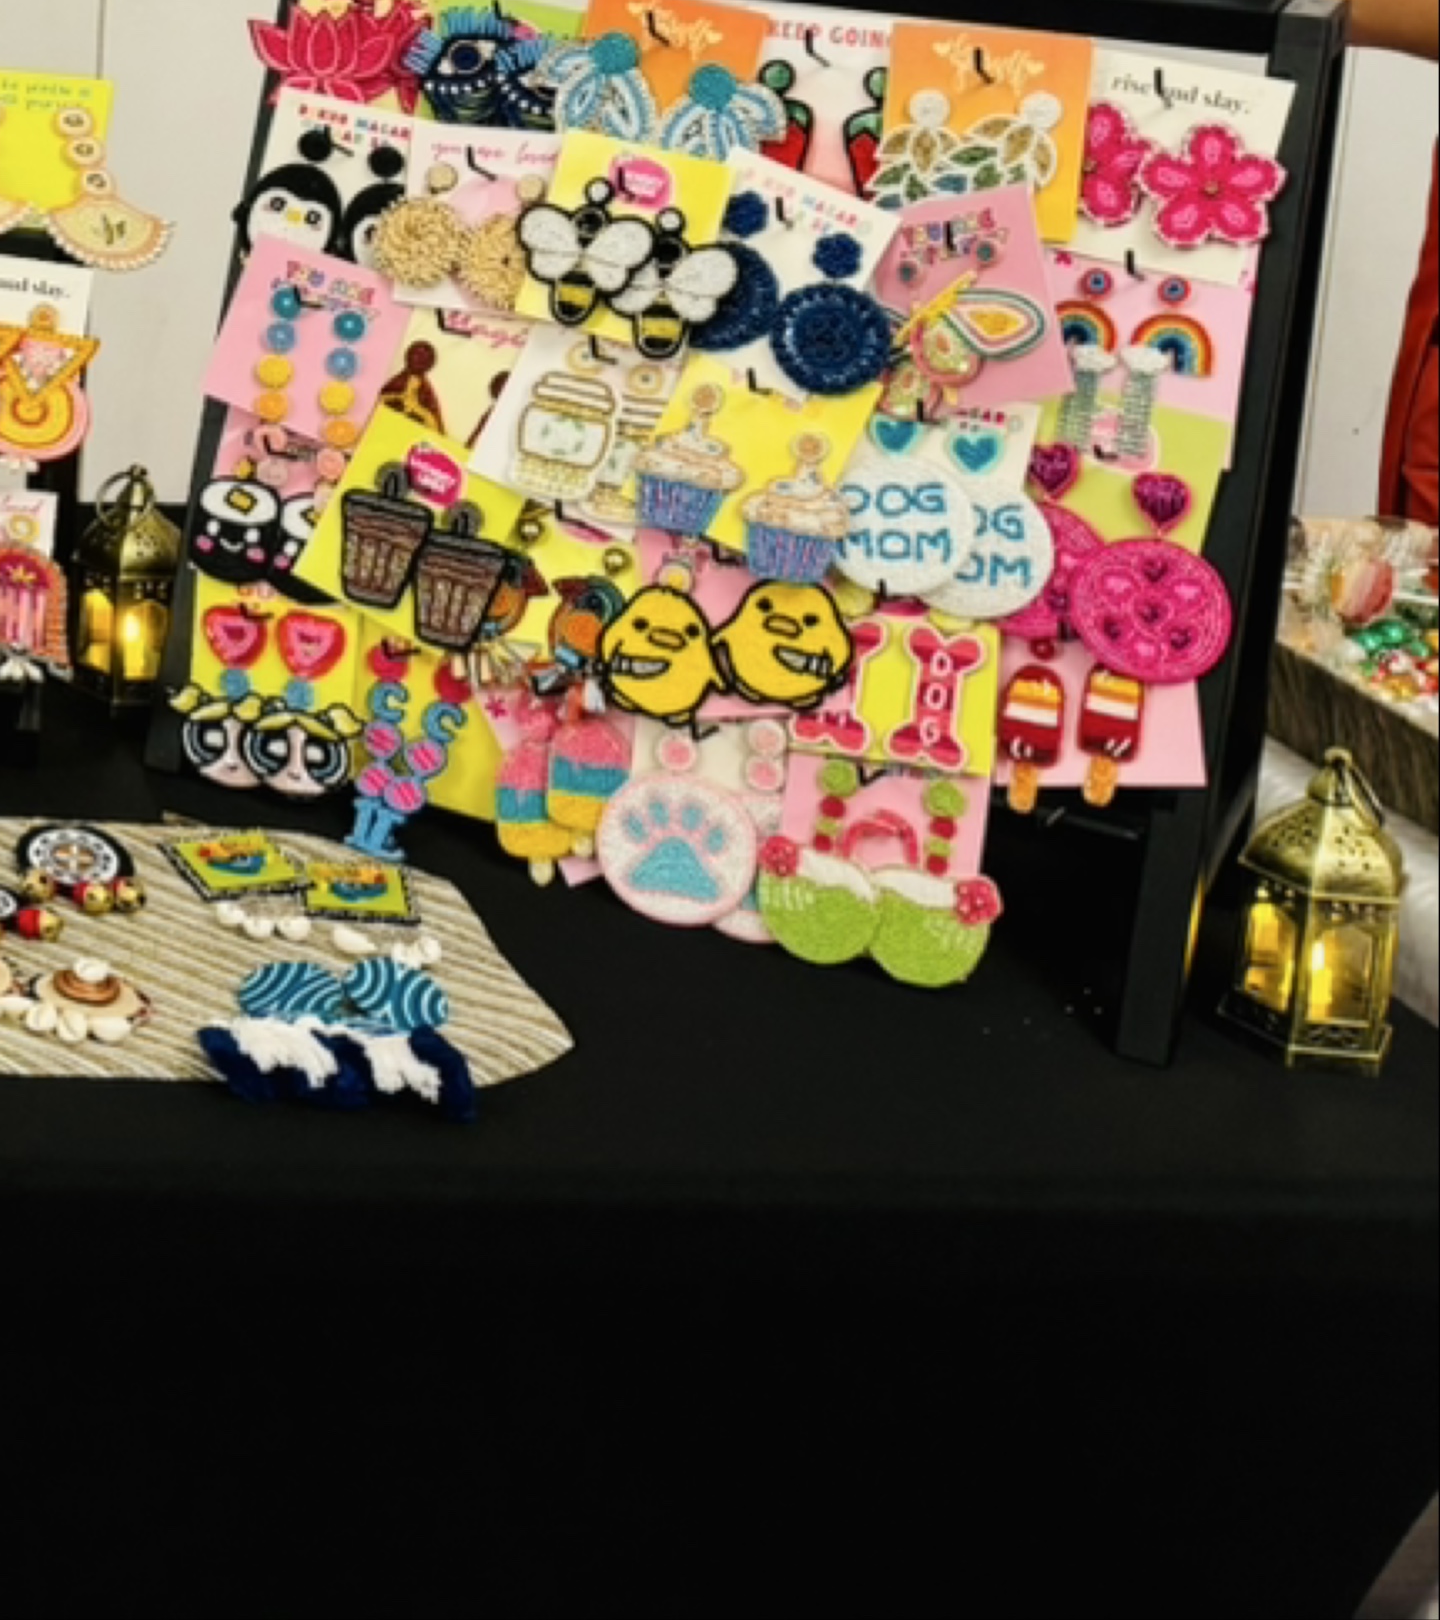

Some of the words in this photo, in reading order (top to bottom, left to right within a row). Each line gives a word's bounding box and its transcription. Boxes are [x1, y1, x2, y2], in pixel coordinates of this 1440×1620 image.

[829, 25, 891, 48] GOIN
[1111, 72, 1152, 96] rise
[839, 481, 946, 518] DOG
[839, 527, 952, 564] MOM
